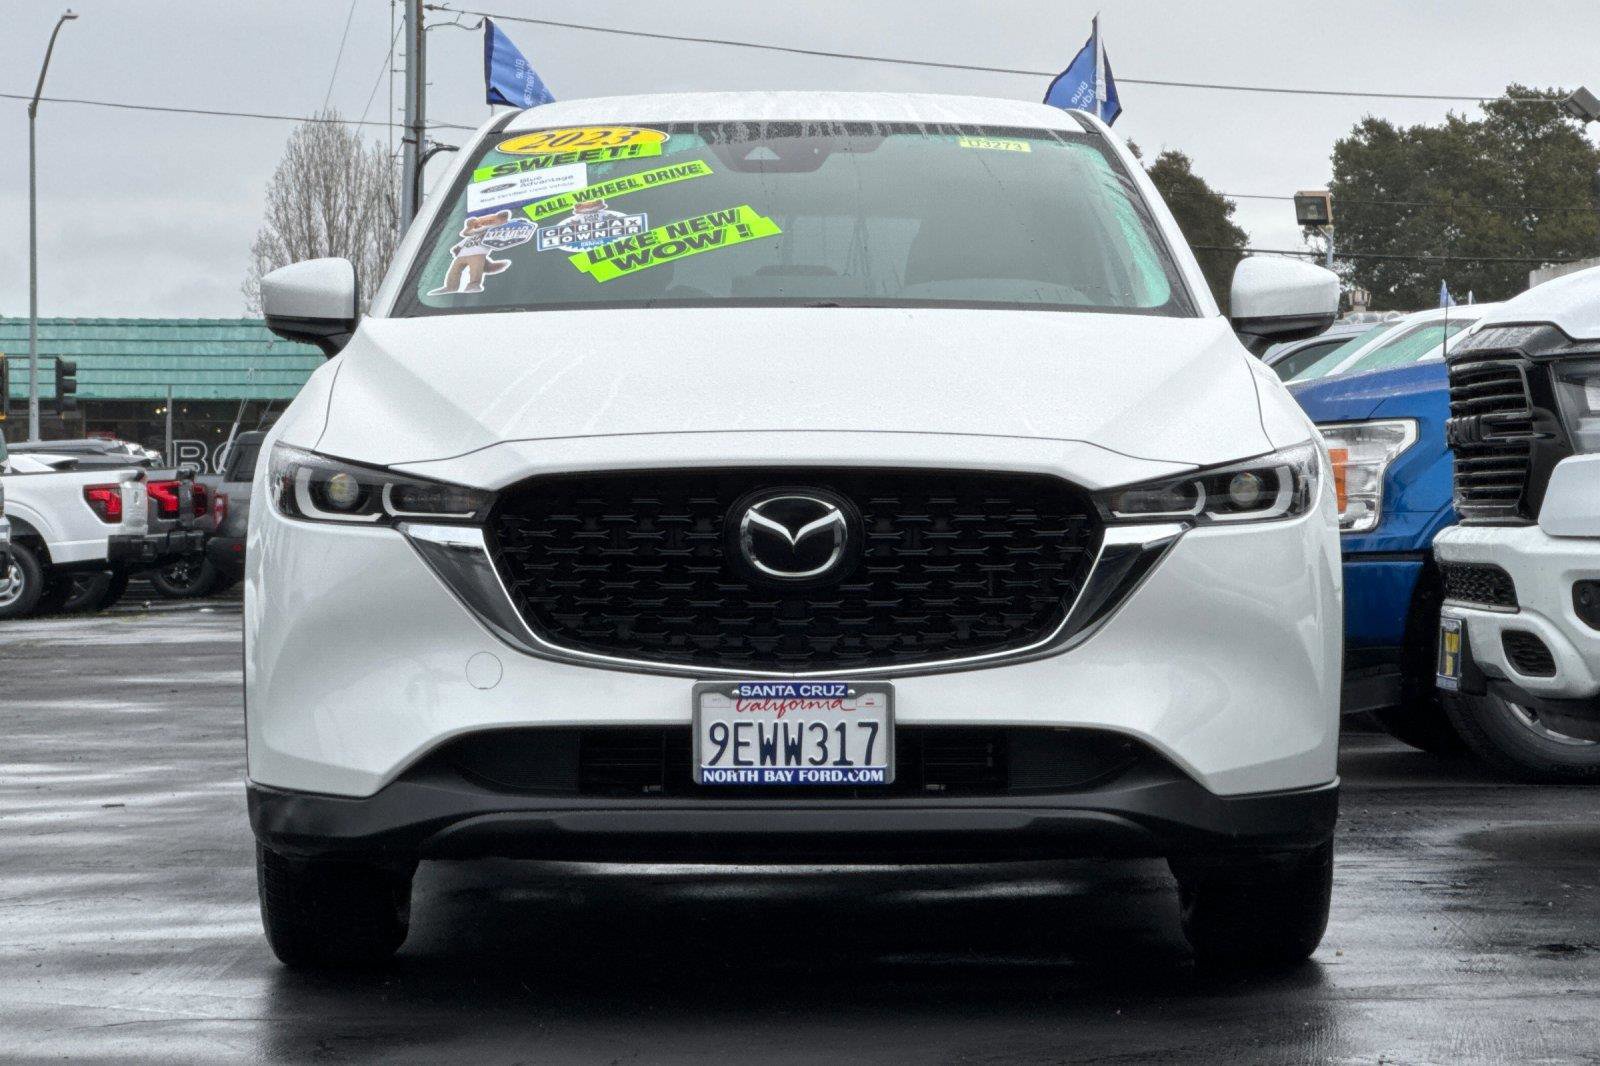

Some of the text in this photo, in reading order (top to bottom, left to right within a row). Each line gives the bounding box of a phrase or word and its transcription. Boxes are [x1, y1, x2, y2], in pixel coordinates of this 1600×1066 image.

[518, 130, 640, 150] 2023
[491, 143, 642, 177] SWEET!
[535, 164, 701, 216] ALL WHEEL DRIVE
[545, 217, 638, 237] CARFAX
[563, 226, 639, 243] OWNER
[587, 209, 738, 264] LIKE NEW
[741, 685, 845, 697] SANTA CRUZ
[736, 698, 857, 719] California
[708, 721, 879, 766] 9EWW317
[703, 770, 884, 782] NORTH BAY FORD.COM
